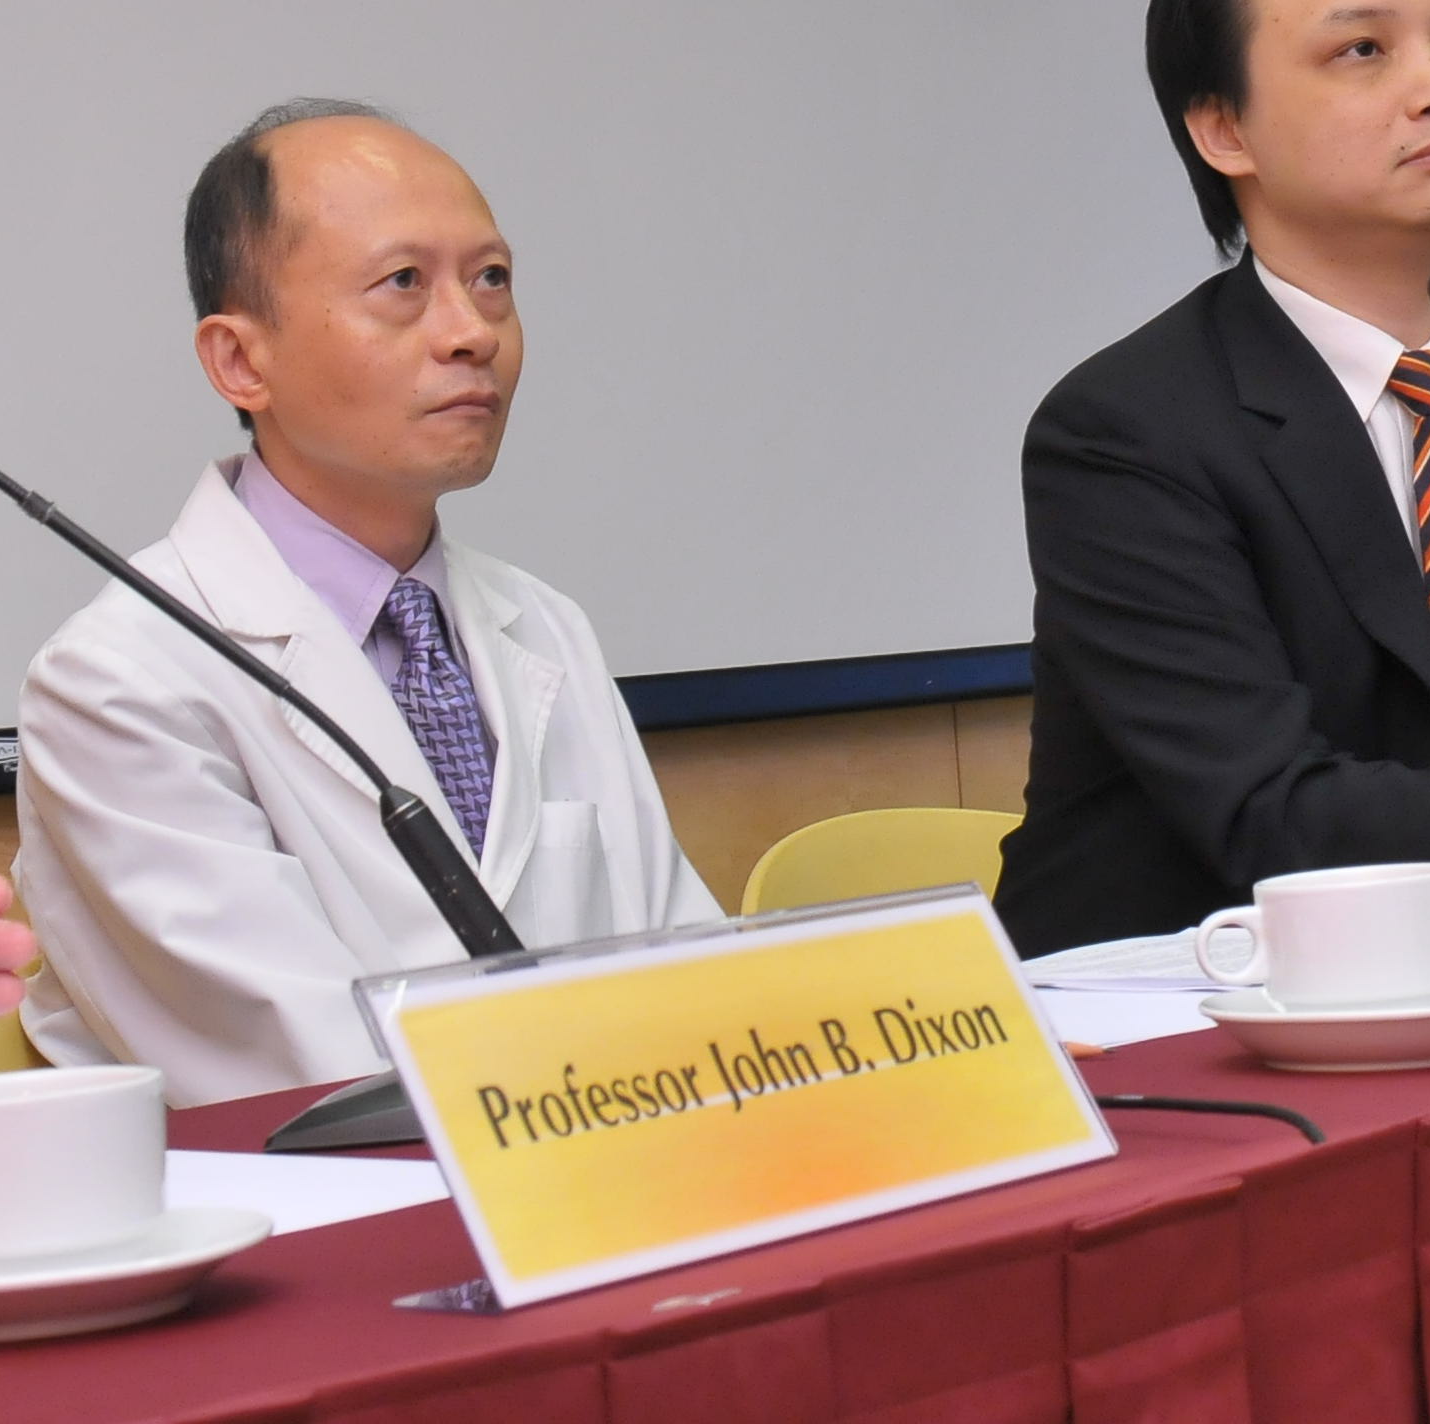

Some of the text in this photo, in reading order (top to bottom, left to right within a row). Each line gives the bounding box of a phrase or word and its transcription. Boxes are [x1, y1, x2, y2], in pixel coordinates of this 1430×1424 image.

[477, 997, 1007, 1148] Professor John B. Dixon
